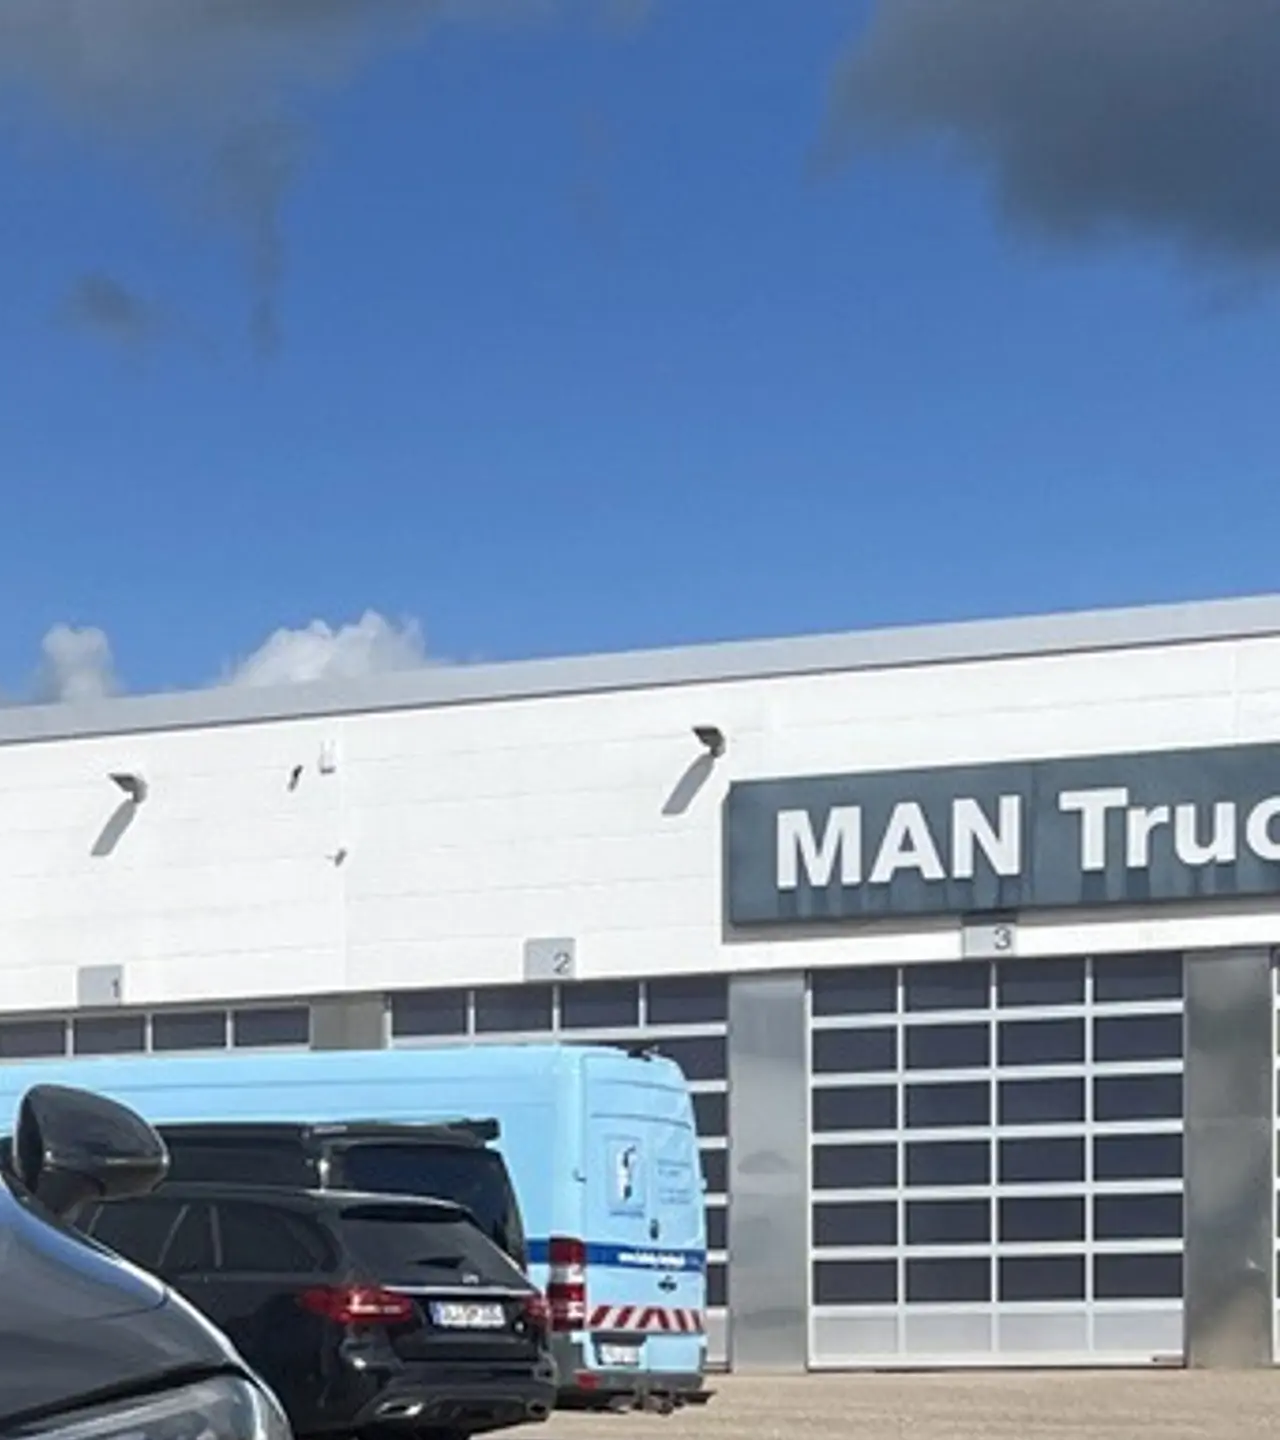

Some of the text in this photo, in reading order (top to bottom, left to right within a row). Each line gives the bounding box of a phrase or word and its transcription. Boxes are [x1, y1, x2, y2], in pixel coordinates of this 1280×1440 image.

[776, 795, 1022, 890] MAN
[994, 926, 1012, 950] 3
[553, 951, 571, 976] 2
